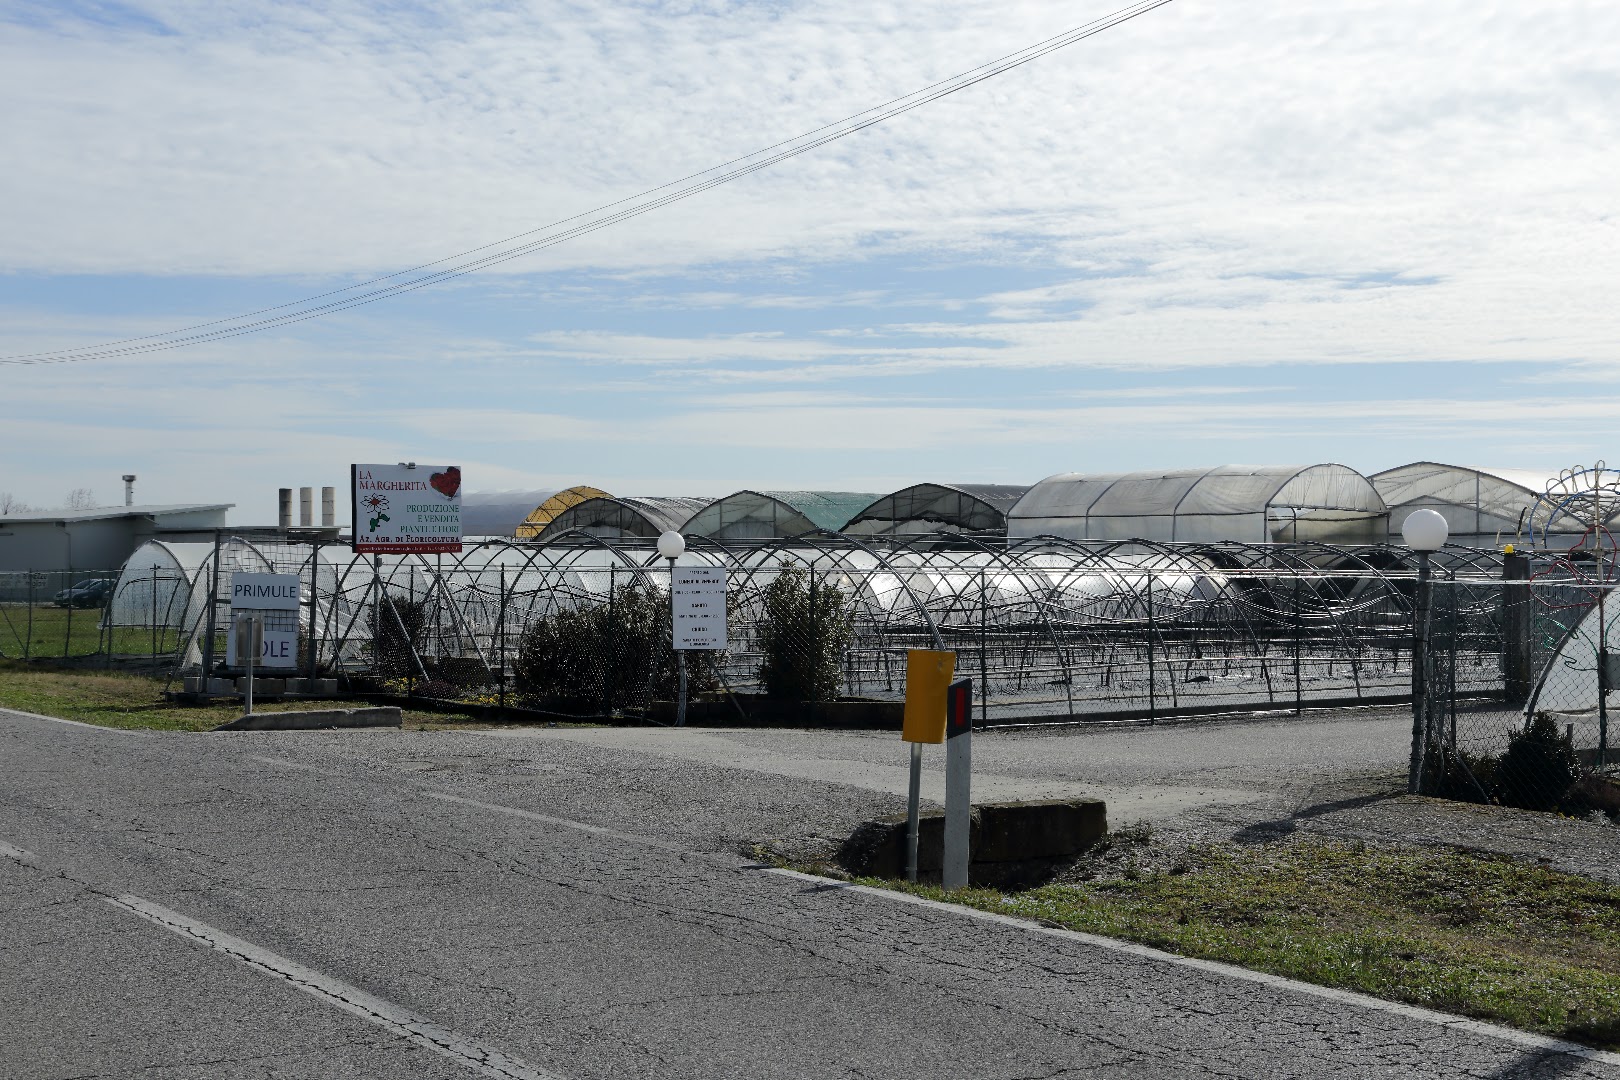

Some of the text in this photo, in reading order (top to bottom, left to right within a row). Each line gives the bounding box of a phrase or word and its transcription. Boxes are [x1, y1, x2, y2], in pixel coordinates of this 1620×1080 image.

[359, 470, 372, 480] LA
[359, 480, 427, 491] MARGHERITA
[406, 504, 460, 513] PRODUZIONE
[424, 514, 459, 523] VENDITA
[234, 584, 297, 599] PRIMULE
